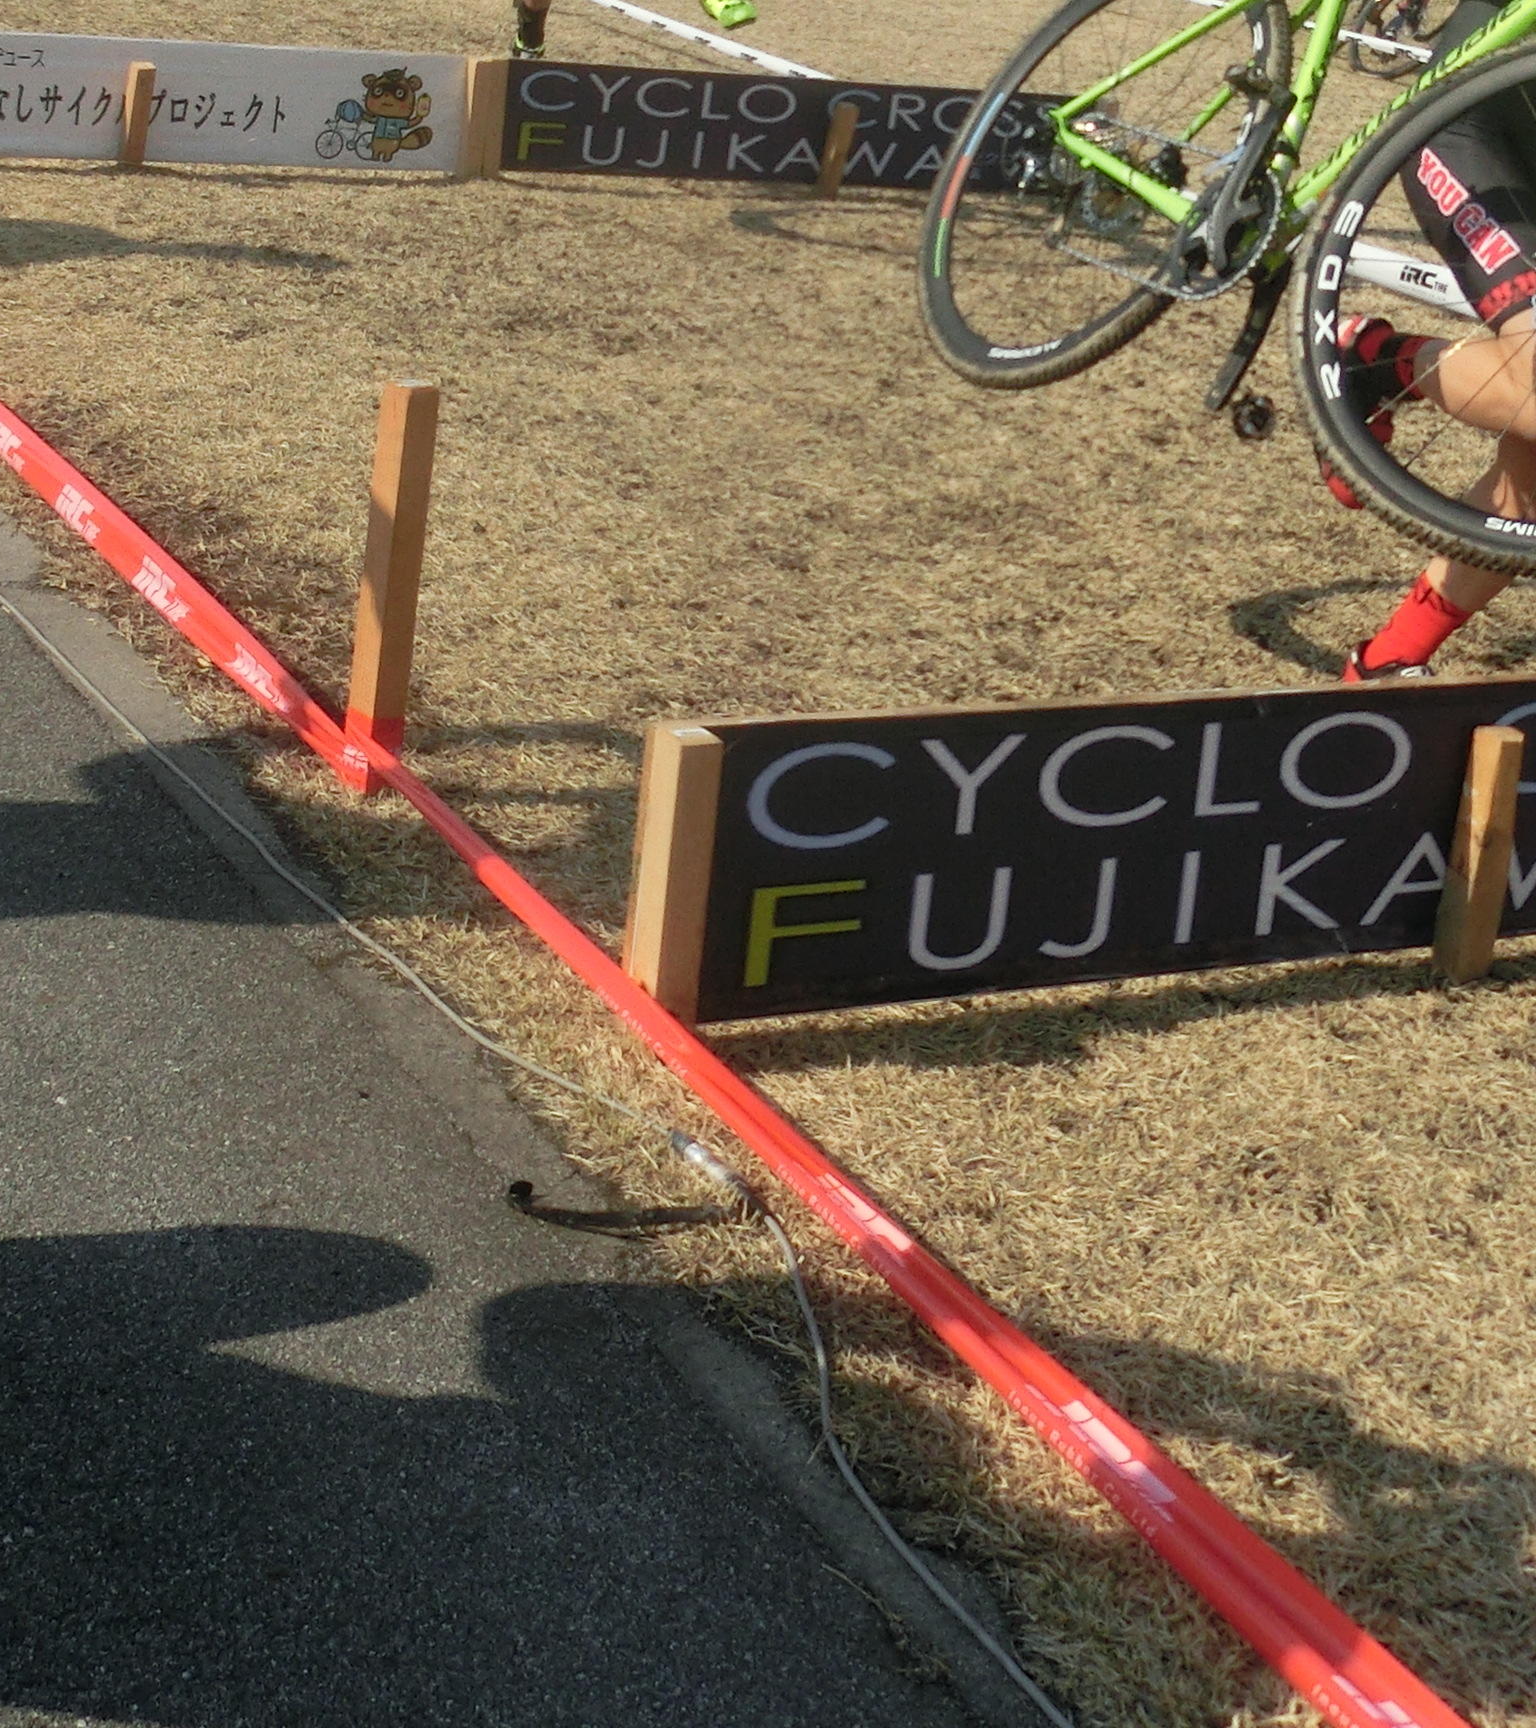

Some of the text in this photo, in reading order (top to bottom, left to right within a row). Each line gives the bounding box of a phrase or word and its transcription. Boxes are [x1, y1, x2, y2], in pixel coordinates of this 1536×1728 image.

[519, 69, 799, 124] CYCLO
[1417, 147, 1470, 217] YOU
[1453, 202, 1521, 275] CAN
[747, 710, 1413, 850] CYCLO
